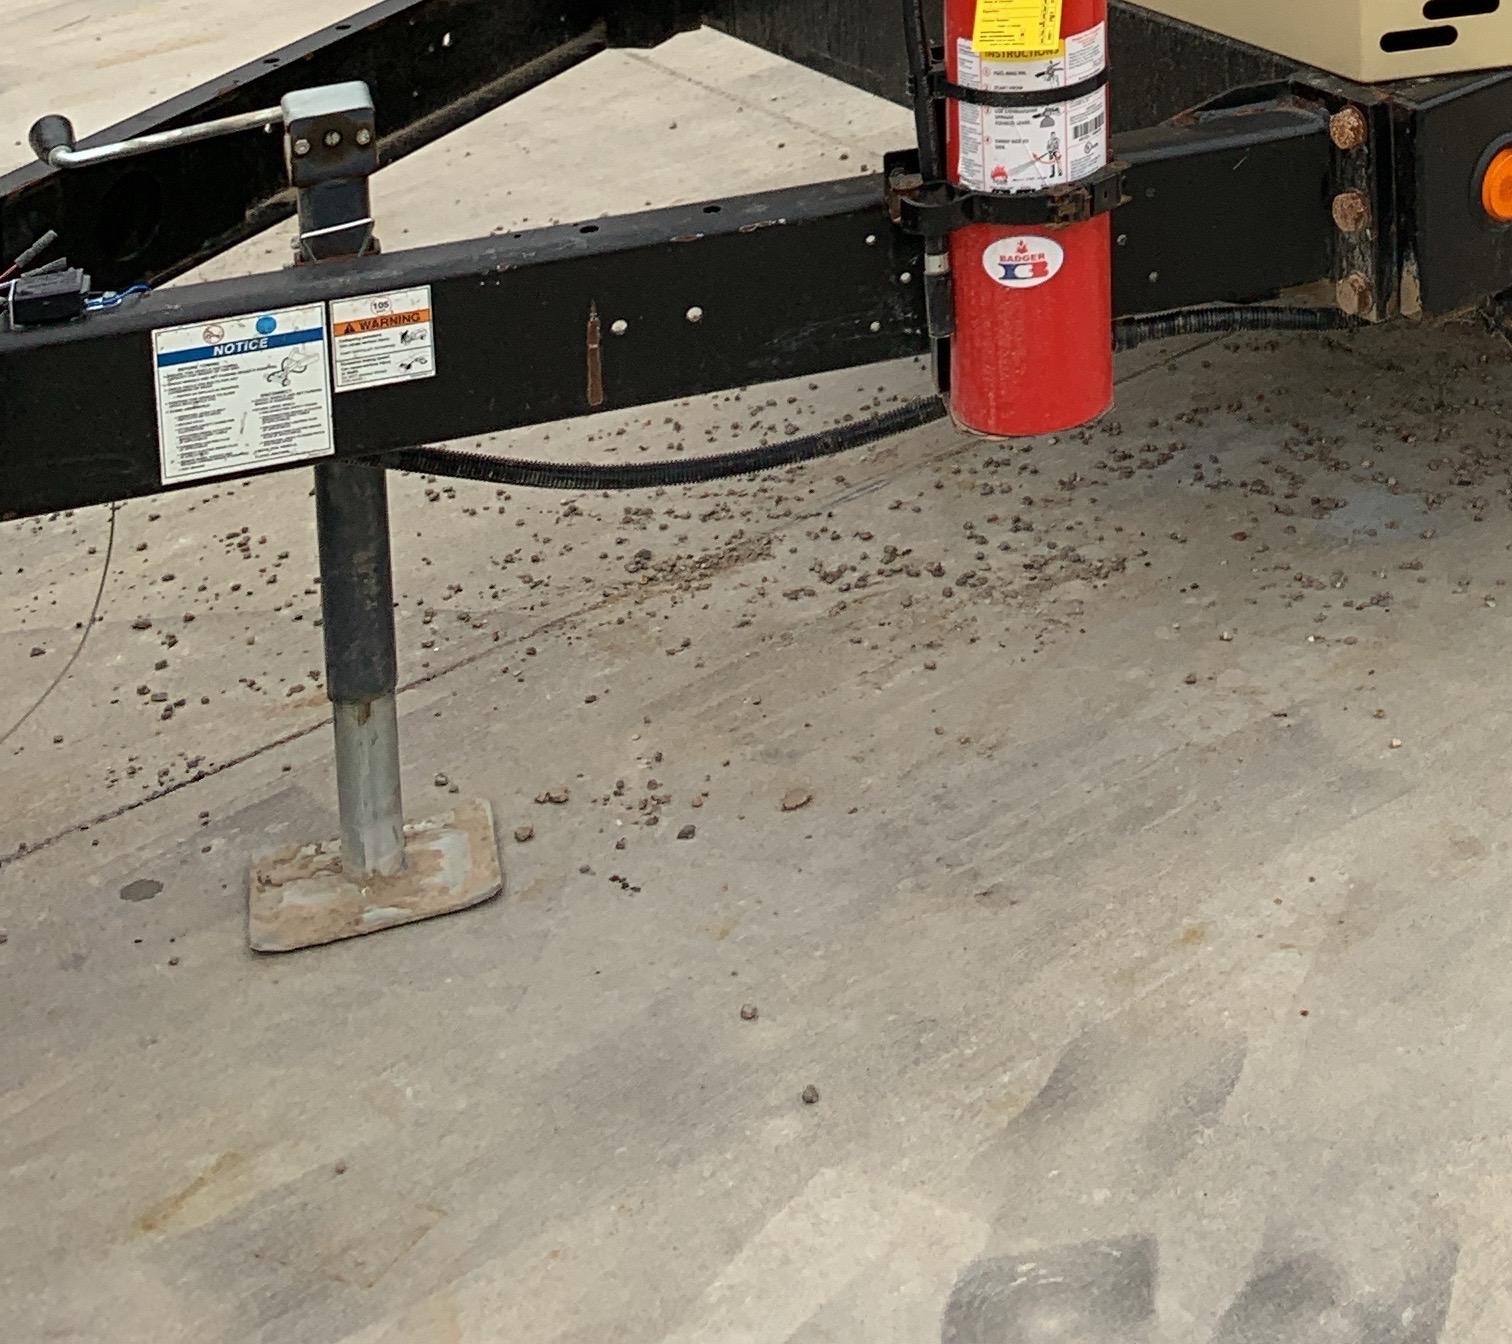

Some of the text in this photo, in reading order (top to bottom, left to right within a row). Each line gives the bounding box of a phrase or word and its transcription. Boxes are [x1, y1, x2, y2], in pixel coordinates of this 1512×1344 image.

[999, 253, 1045, 262] BADGER
[373, 301, 389, 310] 105
[360, 313, 421, 330] WARNING
[213, 338, 268, 356] NOTICE
